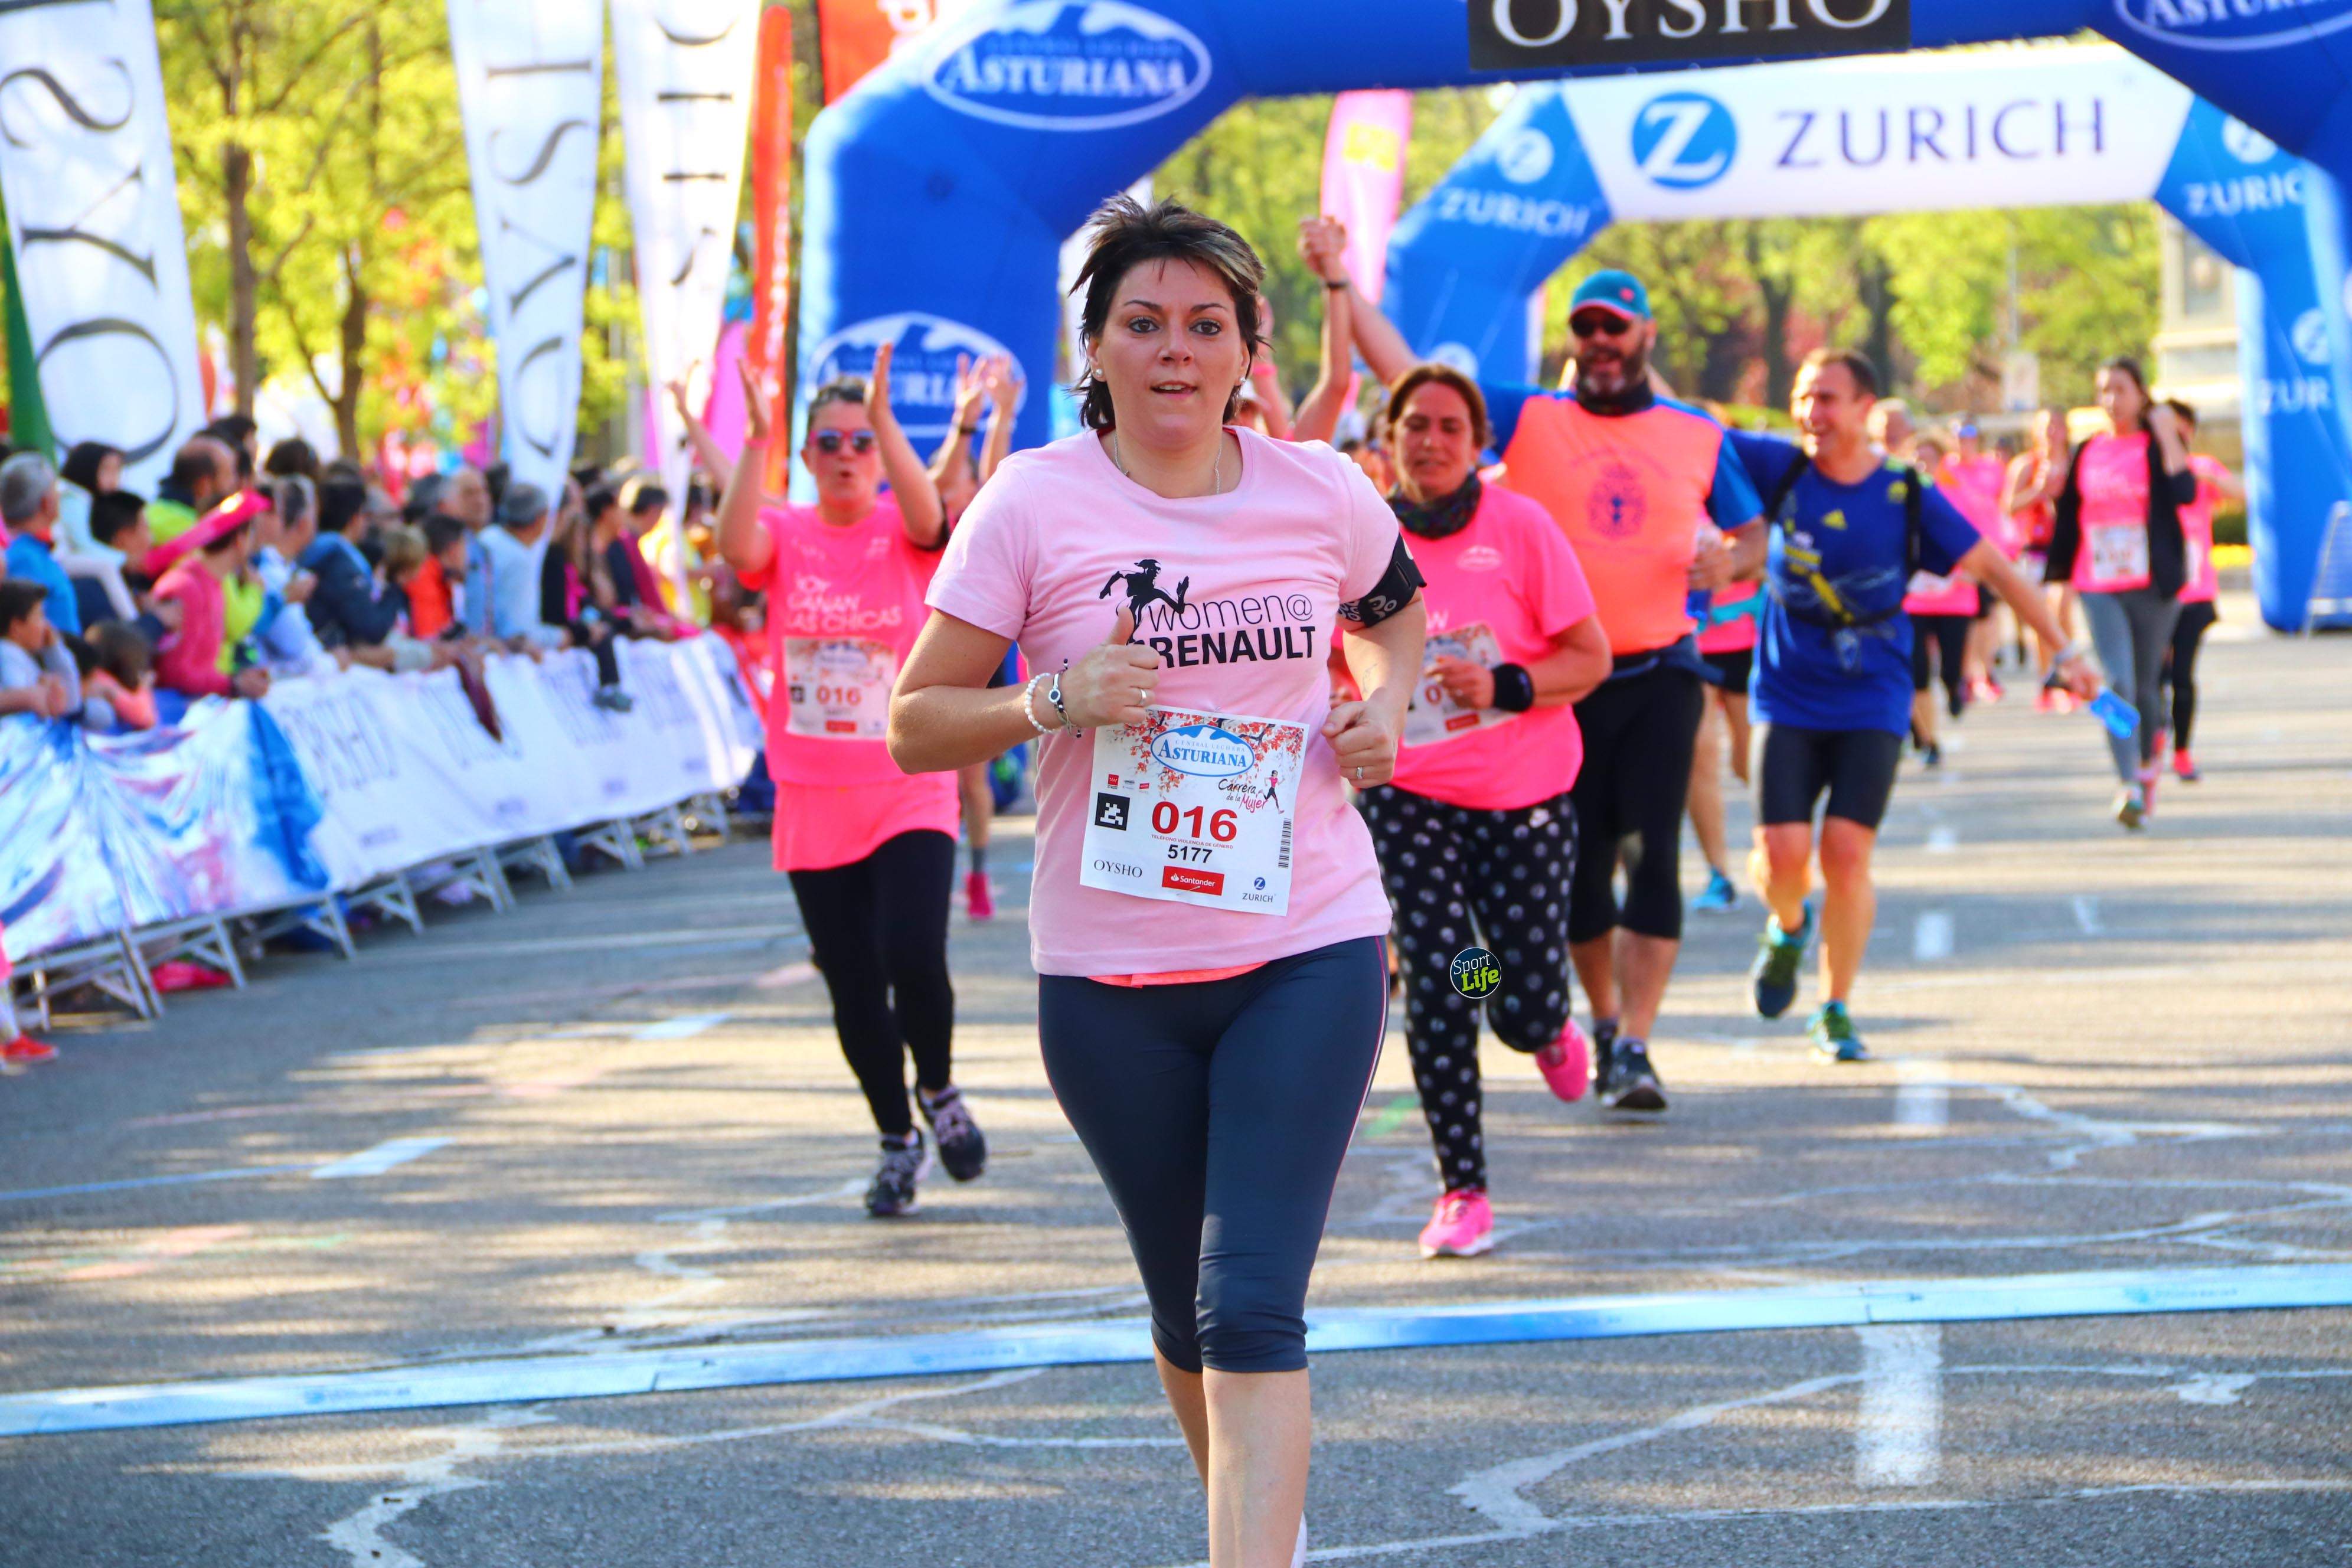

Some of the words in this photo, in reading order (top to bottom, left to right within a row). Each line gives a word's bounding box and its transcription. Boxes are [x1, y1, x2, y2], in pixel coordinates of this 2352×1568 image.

[1492, 0, 1893, 47] OYSHO
[946, 43, 1187, 97] ASTURIANA
[1776, 96, 2105, 168] ZURICH
[1439, 187, 1590, 237] ZURICH
[1148, 593, 1313, 632] women@
[1149, 626, 1315, 669] RENAULT
[816, 685, 862, 705] 016
[1158, 739, 1247, 767] ASTURIANA
[1218, 779, 1257, 794] Carrera
[1226, 792, 1233, 801] de
[1234, 793, 1241, 802] la
[1239, 793, 1268, 814] Mujer
[1151, 801, 1238, 842] 016
[1151, 834, 1177, 842] TELÉFONO
[1168, 844, 1213, 864] 5177
[1093, 859, 1142, 878] OYSHO
[1180, 875, 1216, 887] Santander
[1242, 893, 1273, 903] ZURICH
